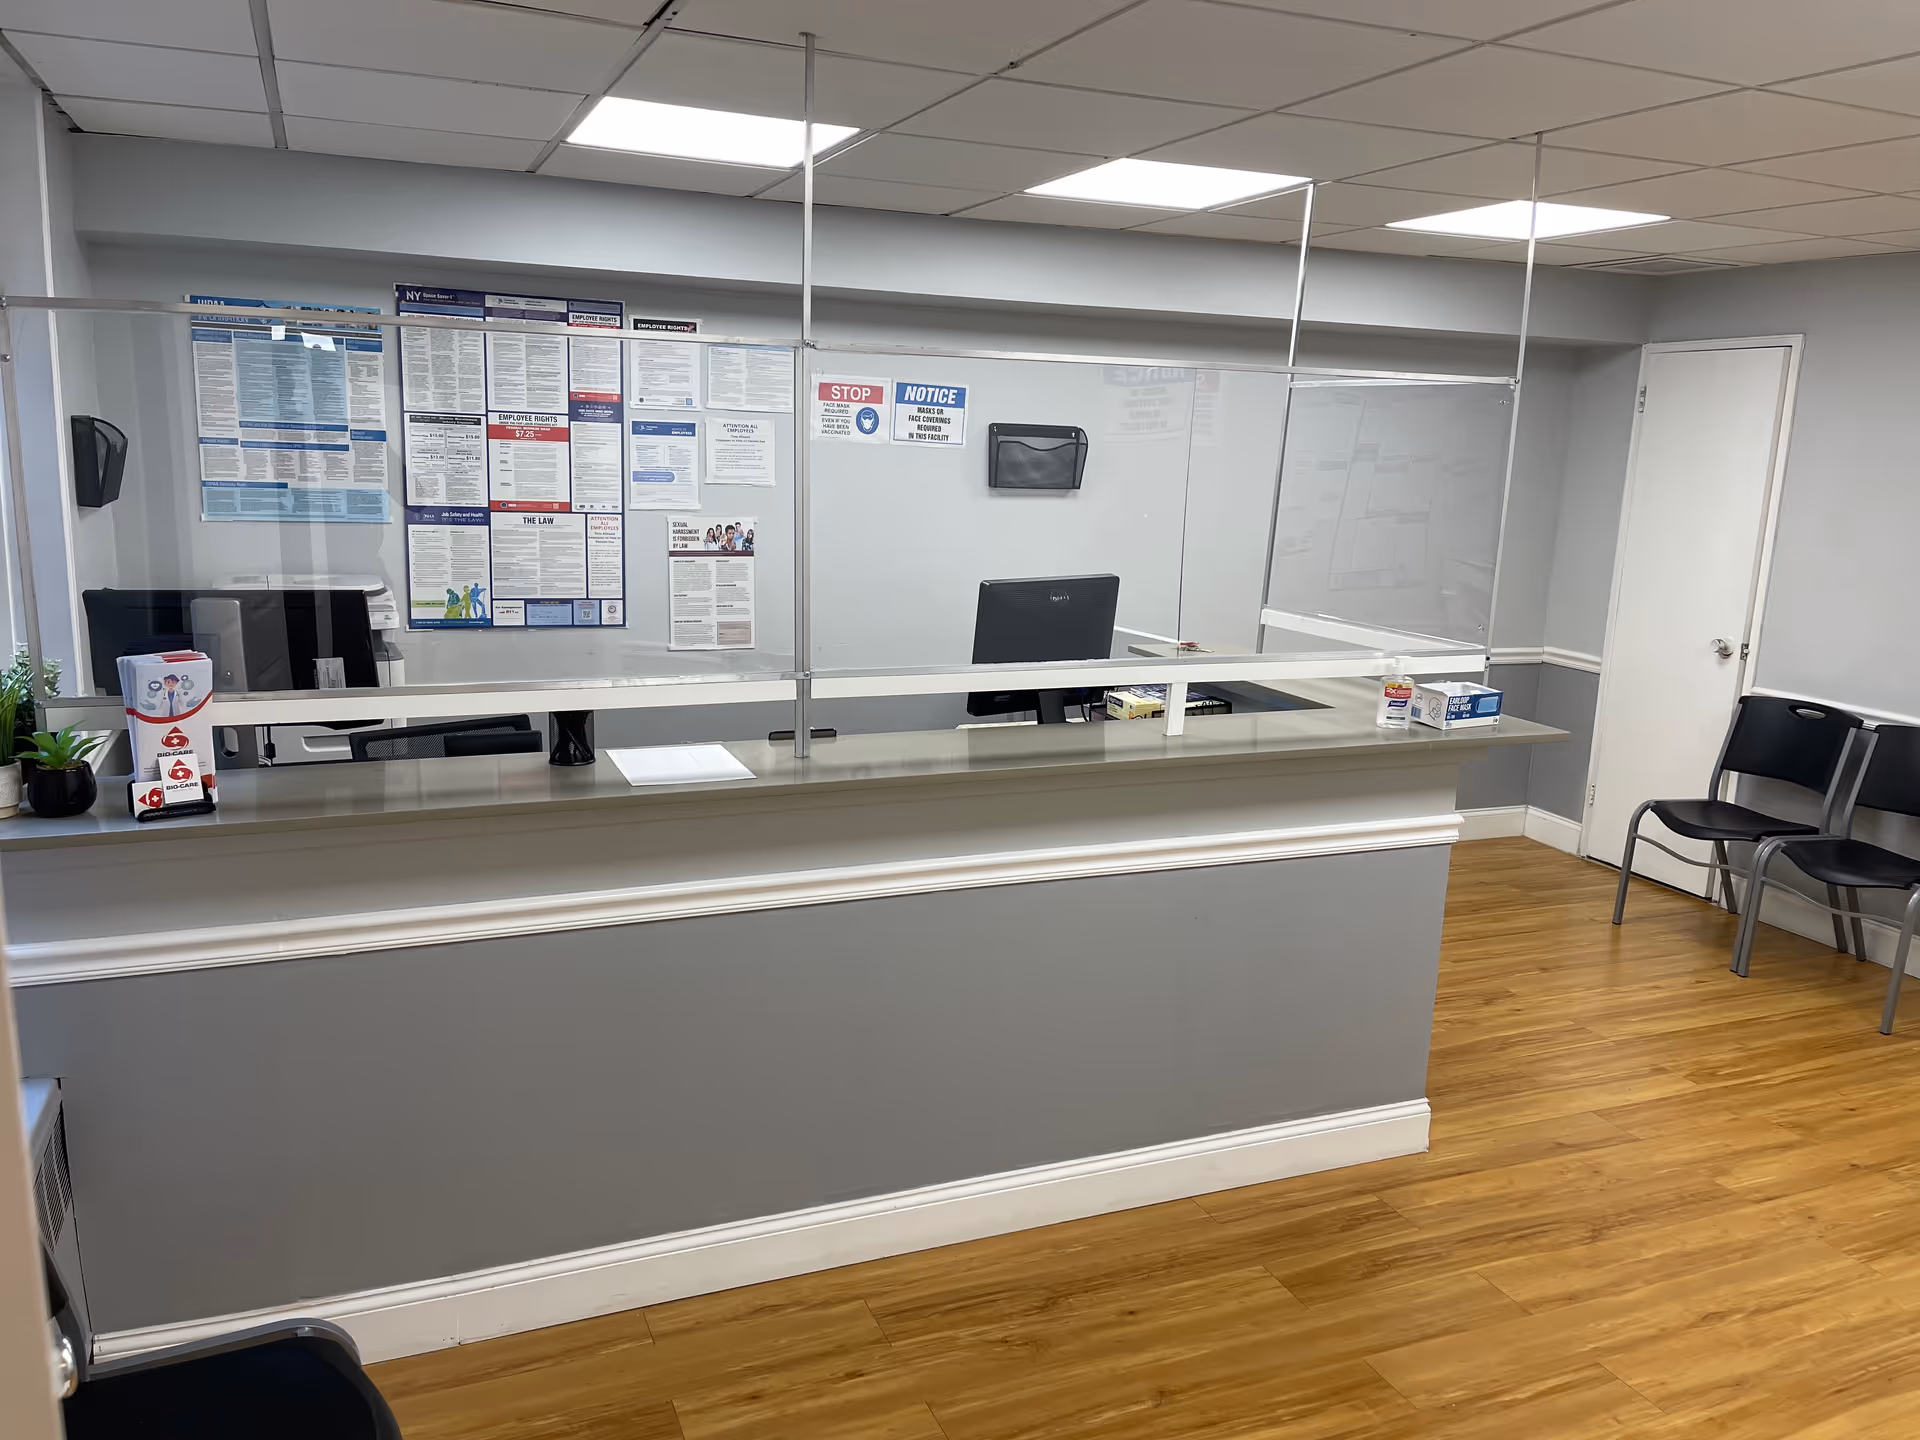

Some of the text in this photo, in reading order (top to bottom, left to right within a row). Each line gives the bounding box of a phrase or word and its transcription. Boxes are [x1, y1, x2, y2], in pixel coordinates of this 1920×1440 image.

[406, 290, 421, 301] NY
[599, 315, 617, 323] RIGHTS
[831, 385, 871, 401] STOP
[904, 385, 958, 404] NOTICE
[917, 406, 936, 415] MASKS
[498, 413, 558, 423] EMPLOYEE RIGHTS
[908, 414, 951, 424] FACE COVERINGS
[917, 424, 942, 432] REQUIRED
[515, 429, 534, 438] $7.25
[915, 432, 927, 440] THIS
[927, 433, 949, 441] FACILITY
[523, 516, 555, 525] THE LAW
[1449, 696, 1470, 705] EARLOOP
[1448, 703, 1472, 712] FACE MASK
[156, 750, 194, 758] BIO-CARE
[166, 782, 199, 790] BIO-CARE
